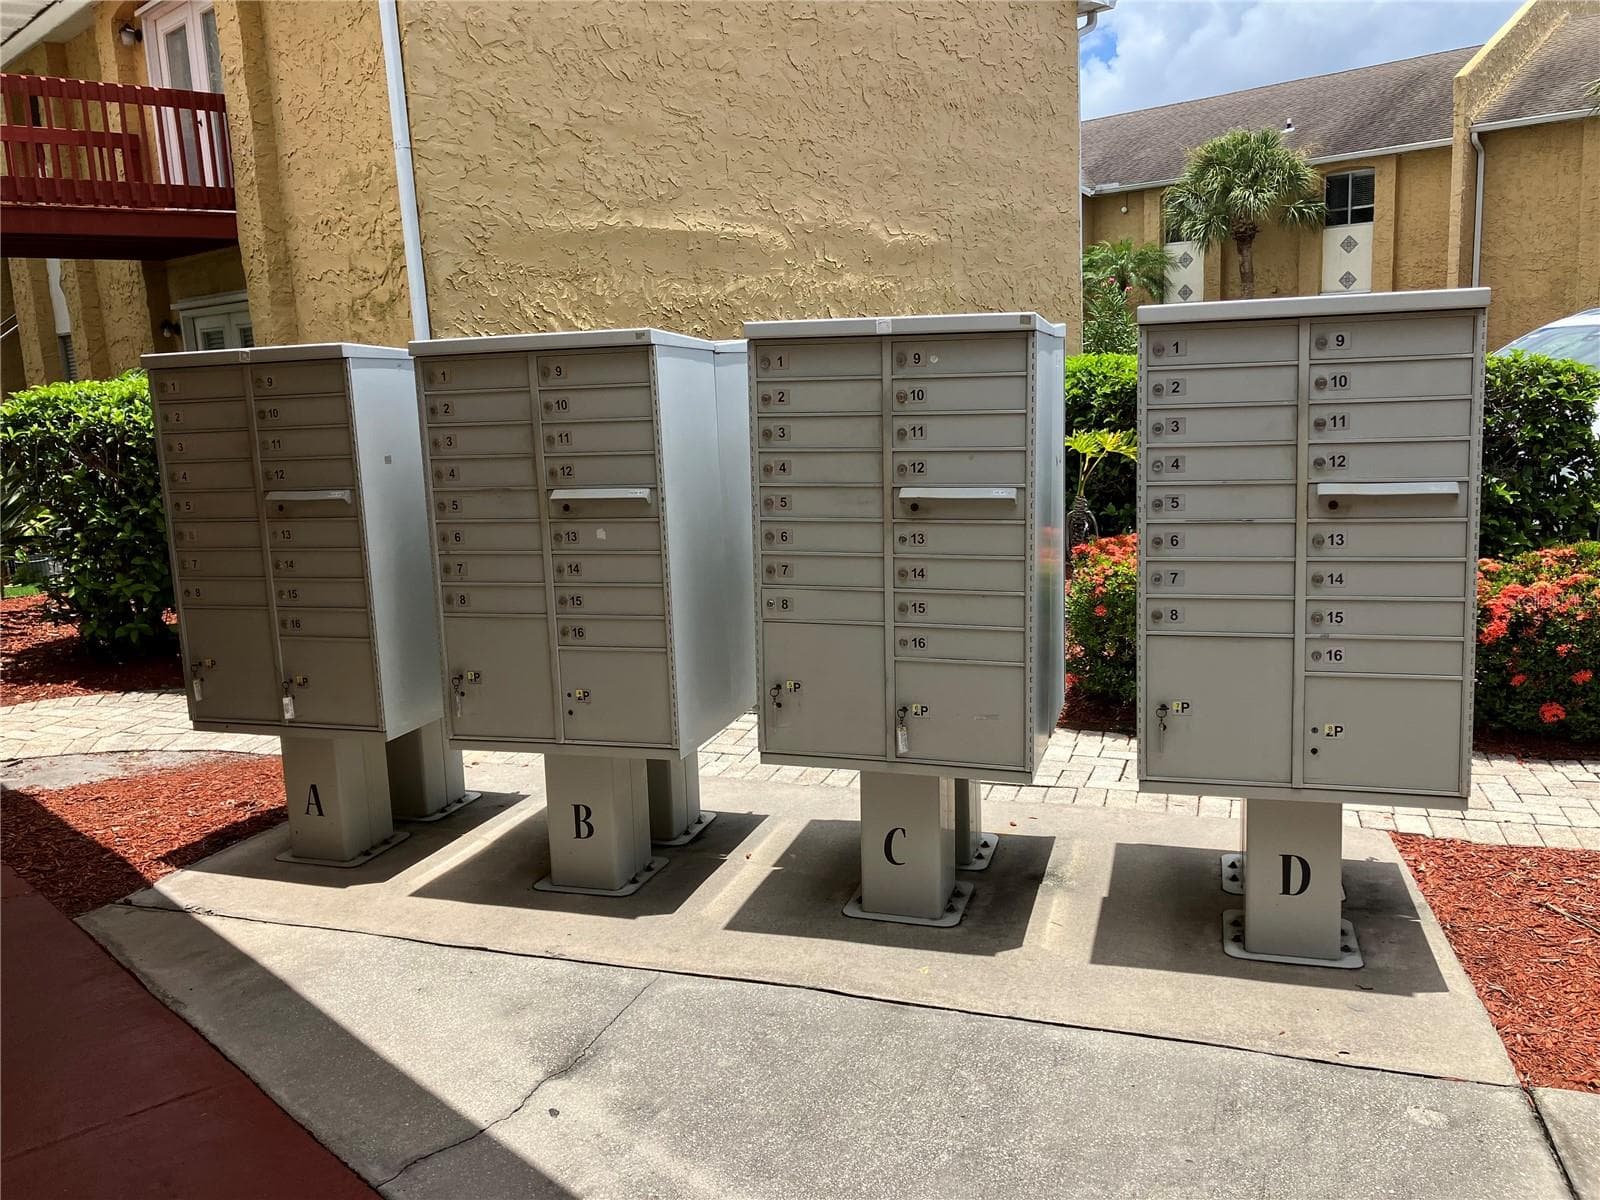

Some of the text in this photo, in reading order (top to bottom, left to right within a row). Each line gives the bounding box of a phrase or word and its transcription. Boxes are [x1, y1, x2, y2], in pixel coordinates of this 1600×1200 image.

[1336, 335, 1345, 346] 9
[1172, 342, 1179, 353] 1
[777, 356, 783, 367] 1
[913, 353, 920, 364] 9
[441, 371, 446, 381] 1
[555, 366, 562, 376] 9
[267, 377, 273, 386] 9
[1330, 375, 1347, 387] 10
[1172, 382, 1180, 393] 2
[778, 392, 785, 402] 2
[910, 390, 924, 400] 10
[443, 404, 449, 413] 2
[555, 400, 567, 410] 10
[175, 413, 180, 421] 2
[268, 409, 278, 417] 10
[1171, 421, 1179, 432] 3
[1330, 416, 1345, 427] 11
[778, 428, 785, 438] 3
[910, 426, 923, 437] 11
[446, 437, 452, 446] 3
[558, 433, 569, 443] 11
[271, 440, 281, 448] 11
[1171, 459, 1180, 470] 4
[1329, 456, 1346, 467] 12
[560, 466, 572, 476] 12
[779, 463, 786, 473] 4
[910, 463, 924, 473] 12
[182, 472, 187, 480] 4
[274, 470, 285, 479] 12
[449, 469, 455, 478] 4
[452, 501, 458, 510] 5
[780, 497, 787, 507] 5
[1171, 497, 1179, 508] 5
[281, 530, 291, 539] 13
[455, 533, 460, 542] 6
[565, 532, 577, 541] 13
[781, 532, 788, 541] 6
[911, 534, 924, 544] 13
[1328, 534, 1344, 545] 13
[1170, 535, 1179, 546] 6
[192, 560, 197, 568] 7
[285, 560, 294, 568] 14
[457, 564, 463, 573] 7
[568, 564, 579, 574] 14
[781, 565, 788, 575] 7
[912, 568, 925, 579] 14
[1170, 573, 1178, 584] 7
[1327, 574, 1343, 585] 14
[287, 590, 297, 598] 15
[460, 595, 466, 604] 8
[570, 596, 582, 605] 15
[781, 599, 788, 609] 8
[912, 603, 925, 613] 15
[1170, 610, 1178, 620] 8
[1327, 612, 1343, 623] 15
[291, 620, 300, 628] 16
[572, 628, 584, 637] 16
[912, 638, 925, 648] 16
[1326, 650, 1342, 661] 16
[1176, 702, 1190, 713] P
[304, 784, 324, 817] A
[572, 804, 594, 839] B
[884, 827, 907, 866] C
[1279, 854, 1311, 896] D
